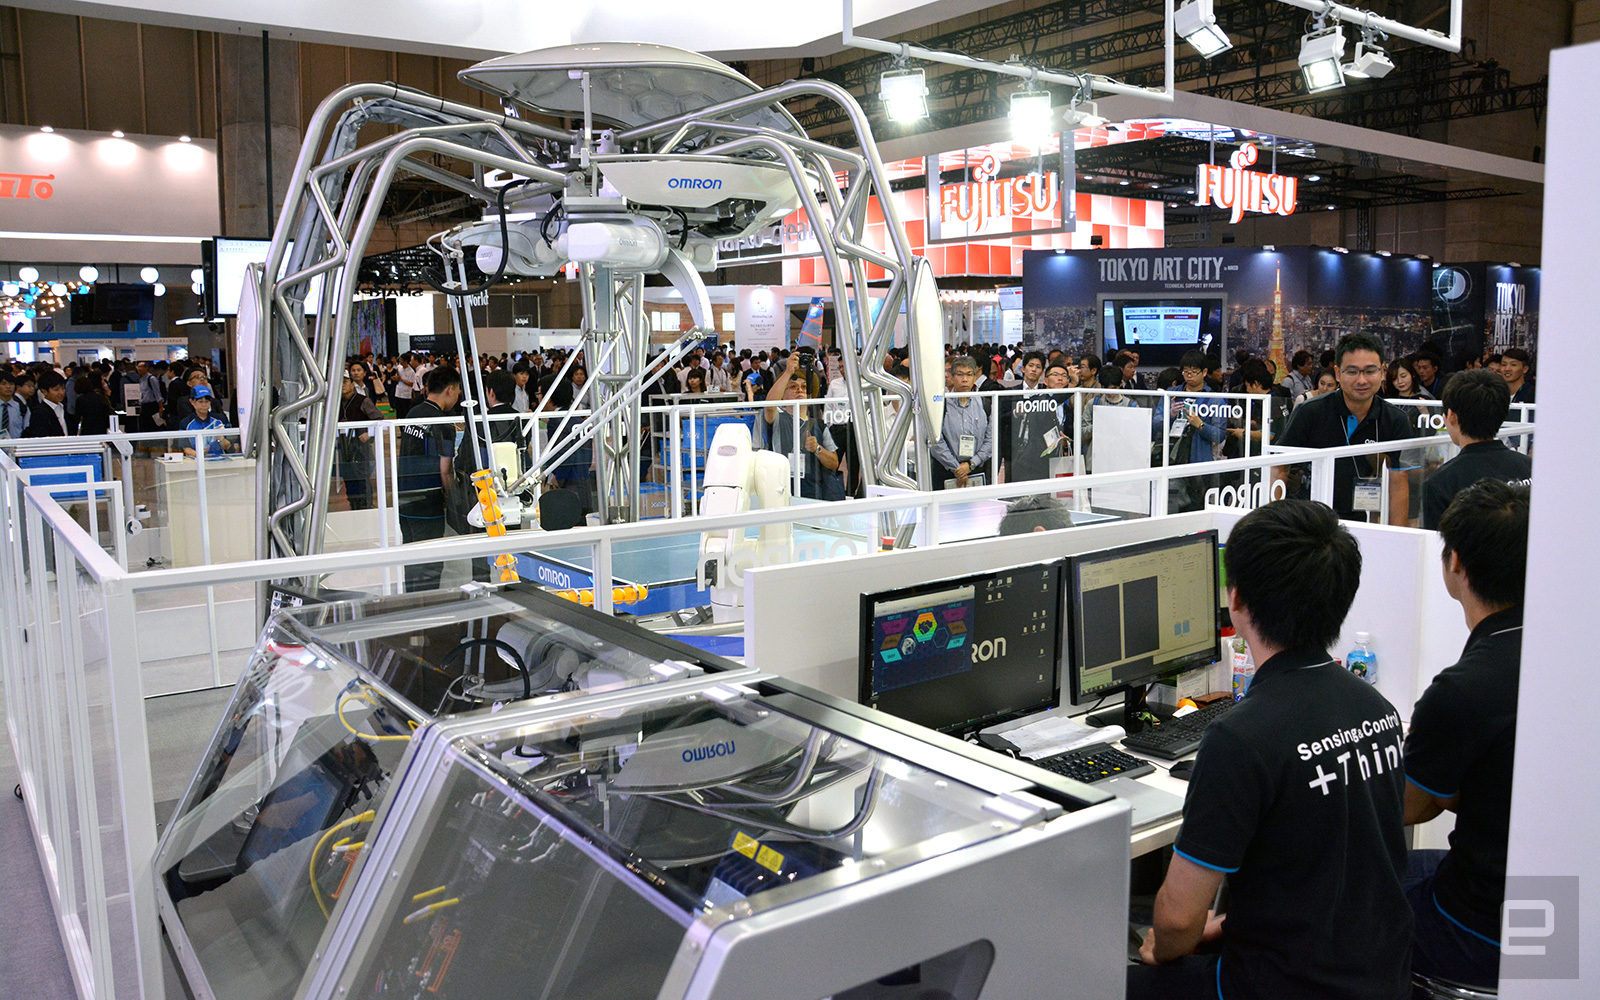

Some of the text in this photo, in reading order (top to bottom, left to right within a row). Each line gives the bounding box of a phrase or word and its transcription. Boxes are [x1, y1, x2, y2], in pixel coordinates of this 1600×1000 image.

[667, 178, 723, 190] OMRON
[1196, 163, 1298, 224] FUJITSU
[940, 171, 1058, 233] FUJITSU
[1098, 258, 1148, 281] TOKYO
[1153, 257, 1183, 281] ART
[1188, 257, 1224, 280] CITY
[1496, 283, 1525, 315] TOKYO
[1493, 314, 1512, 345] ART
[538, 566, 571, 589] OMRON
